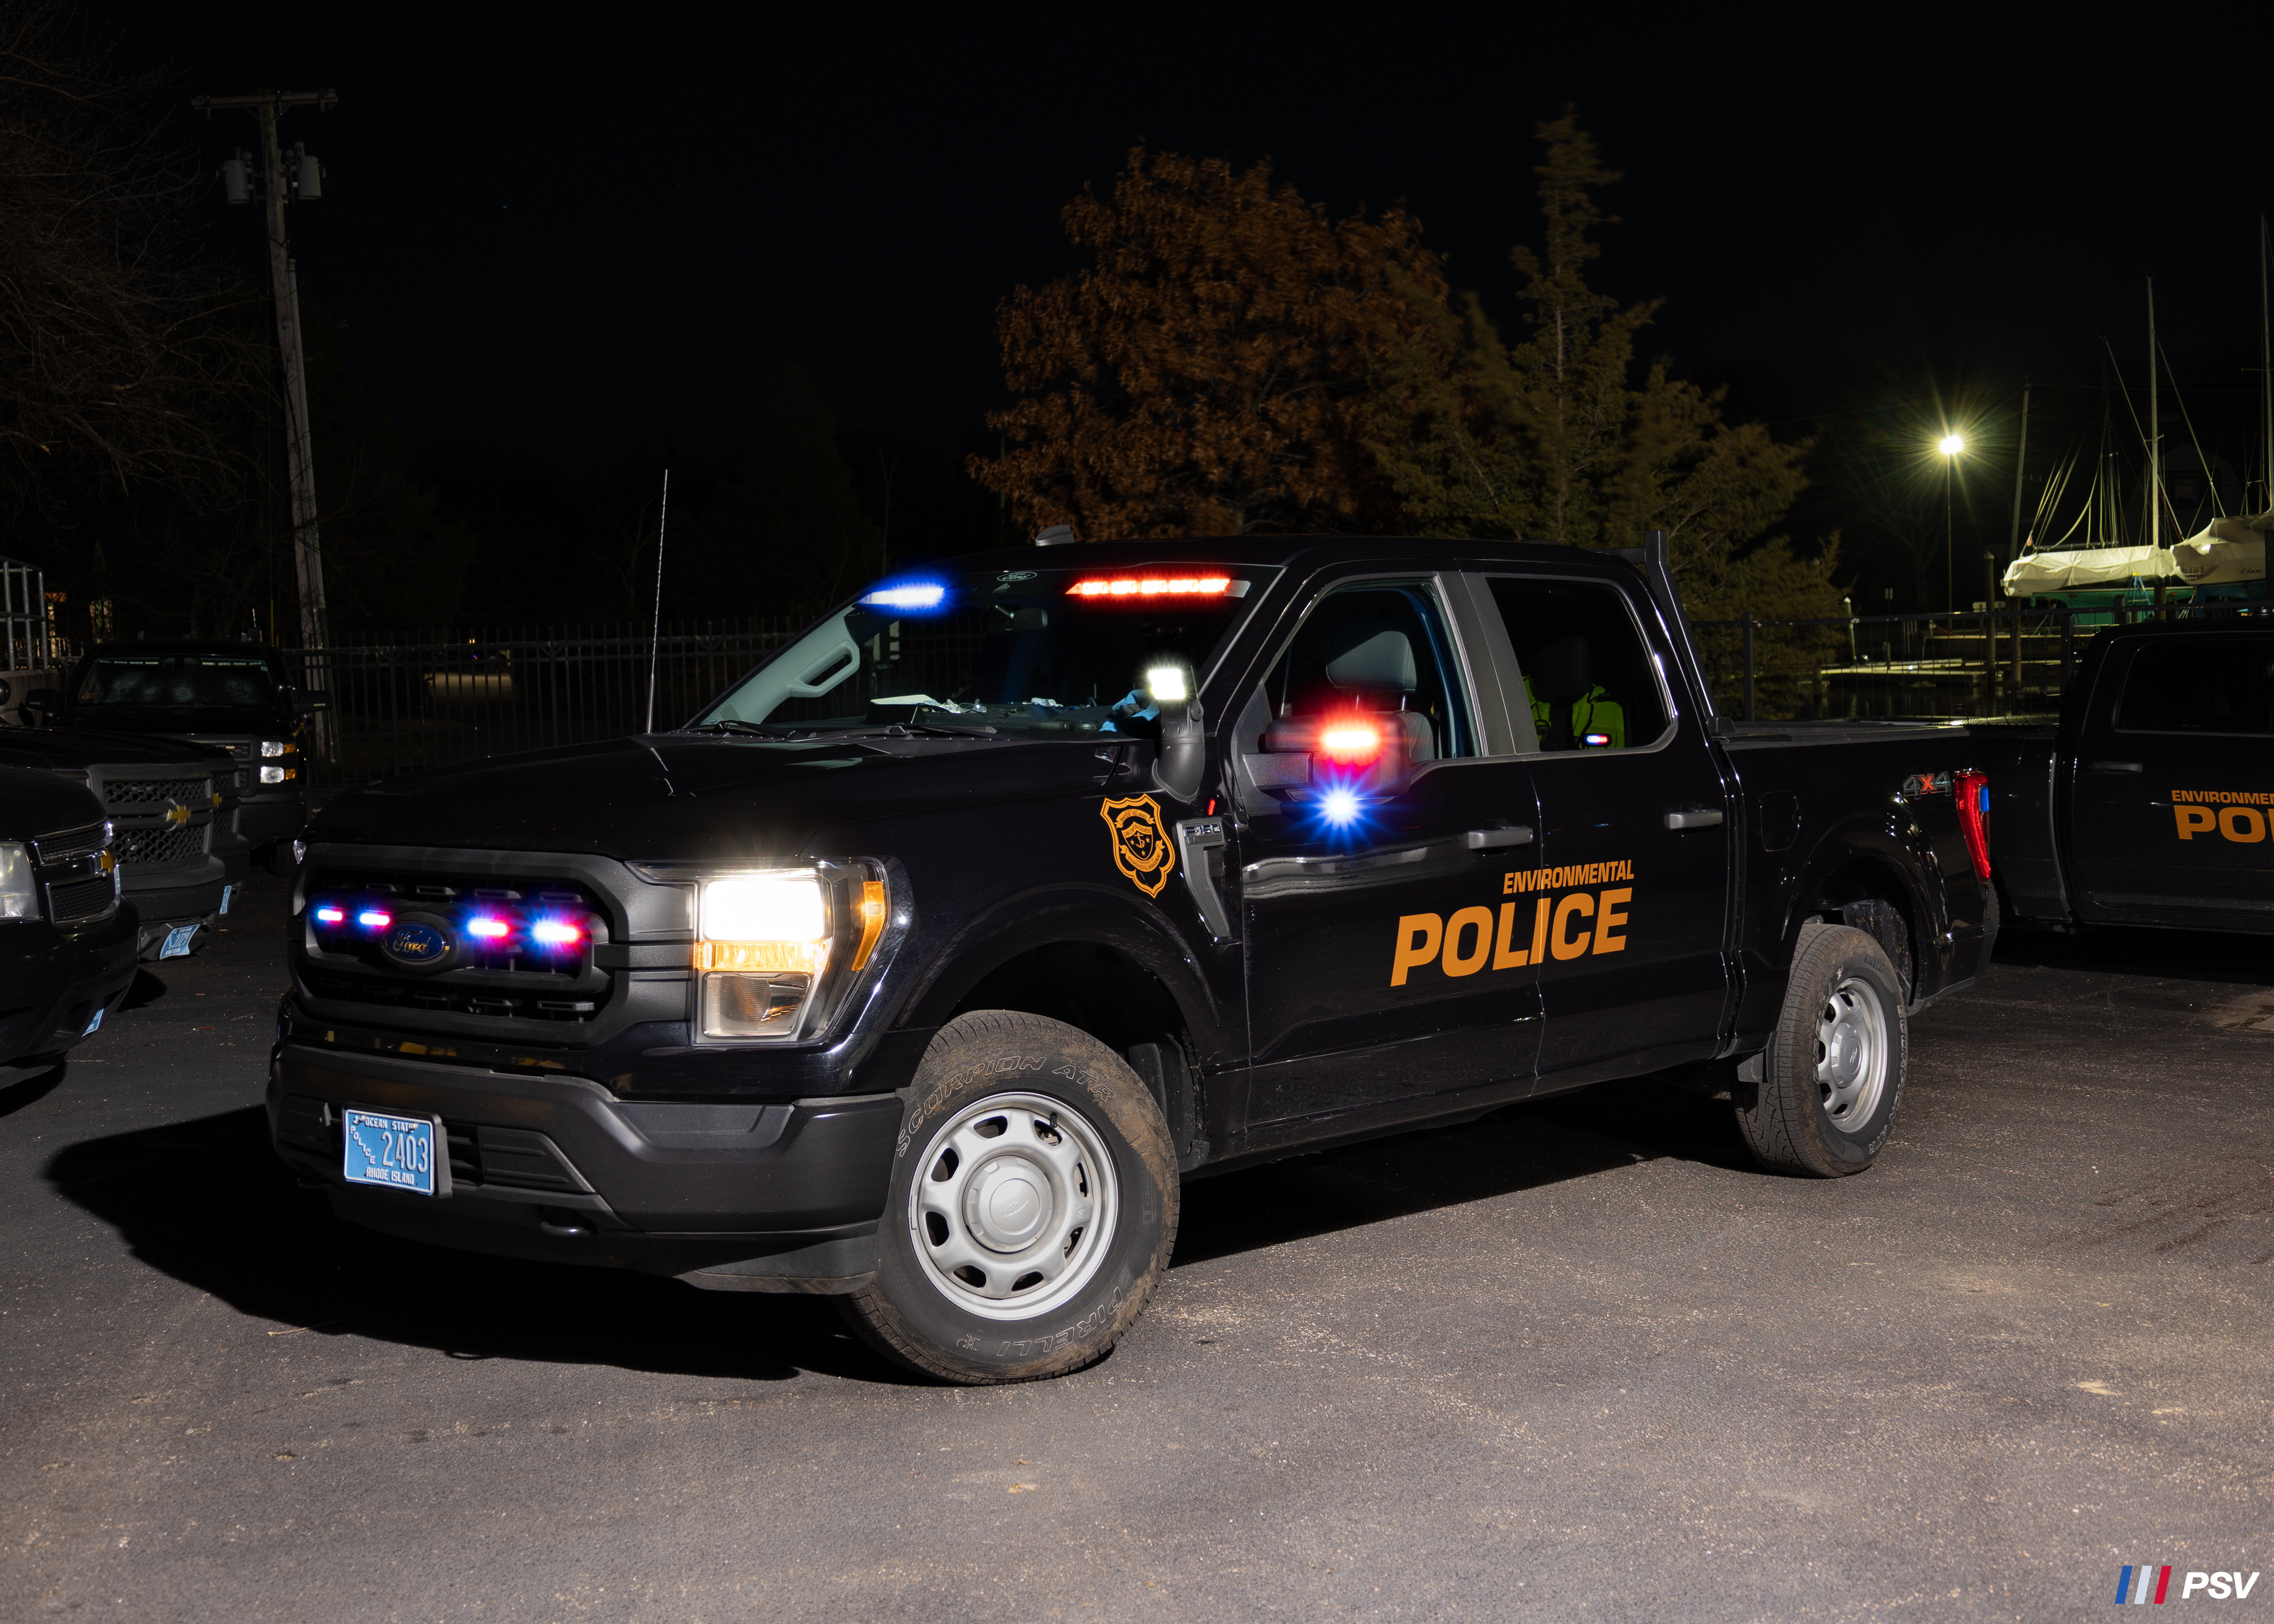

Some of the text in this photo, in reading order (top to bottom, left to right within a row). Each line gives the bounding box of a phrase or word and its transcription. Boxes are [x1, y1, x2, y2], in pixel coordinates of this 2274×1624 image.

[1002, 572, 1032, 580] Ford
[2240, 567, 2263, 575] Elan
[1120, 811, 1147, 823] RHODE ISLAND
[2173, 805, 2274, 843] PO
[1503, 859, 1634, 894] ENVIRONMENTAL
[393, 928, 432, 955] Ford
[1390, 887, 1633, 987] POLICE
[365, 1116, 388, 1129] OCEAN
[896, 1055, 1046, 1157] SCORPION
[1052, 1064, 1116, 1103] ATR
[350, 1125, 376, 1165] POLICE
[381, 1131, 428, 1174] 2403
[366, 1166, 415, 1186] RHODE ISLAND
[995, 1286, 1123, 1357] PIRELLI
